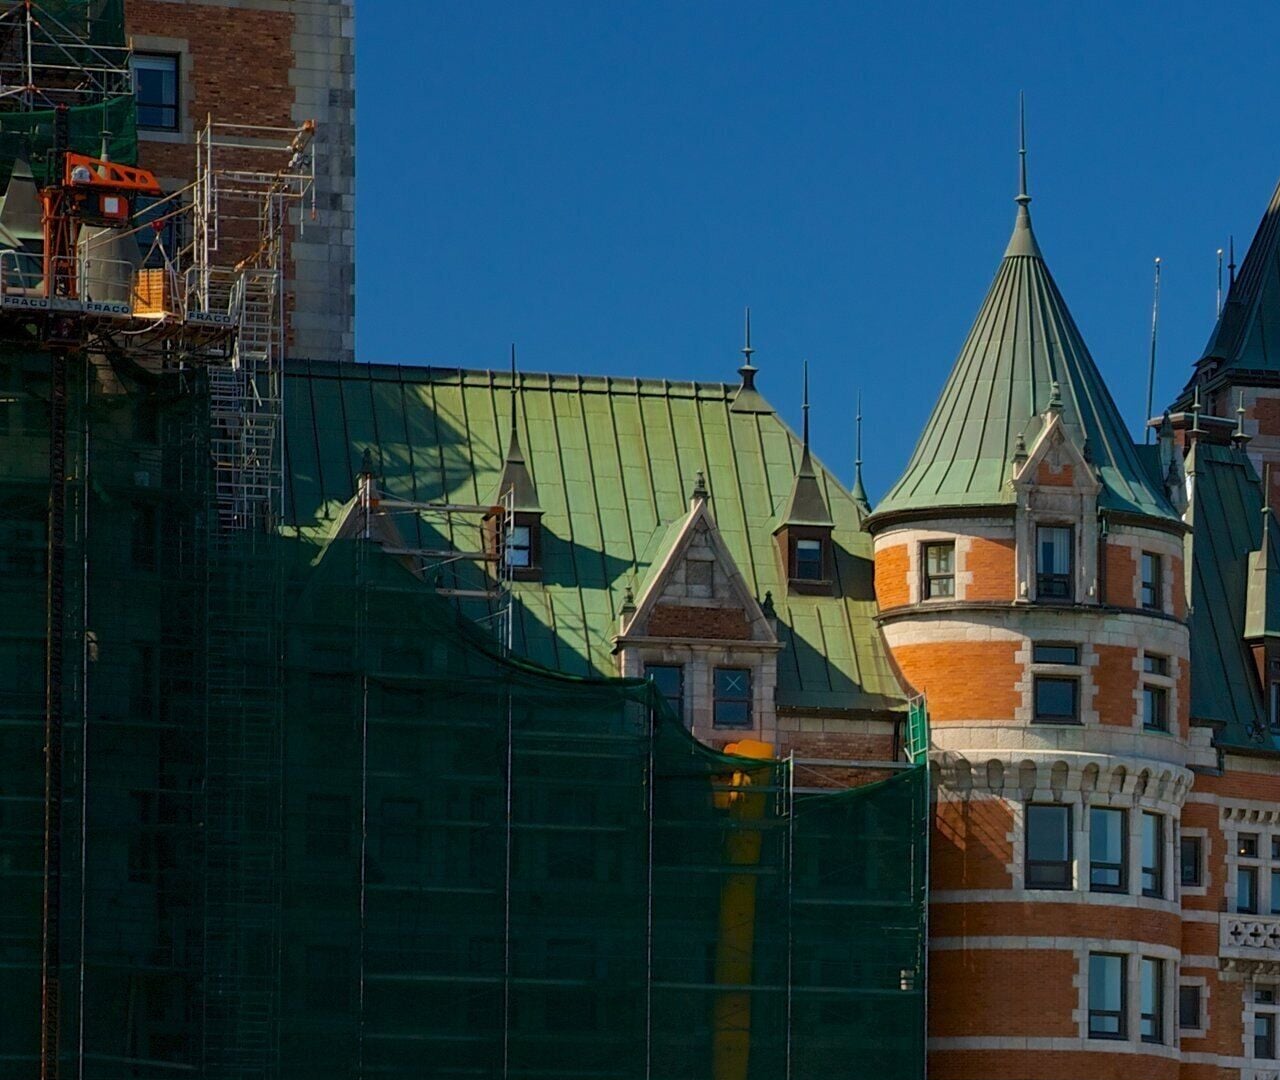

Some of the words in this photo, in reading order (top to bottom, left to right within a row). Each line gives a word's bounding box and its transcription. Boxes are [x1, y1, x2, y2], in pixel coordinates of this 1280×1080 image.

[4, 297, 47, 307] FRACO
[87, 303, 129, 314] FRACO
[188, 312, 231, 323] FRACO
